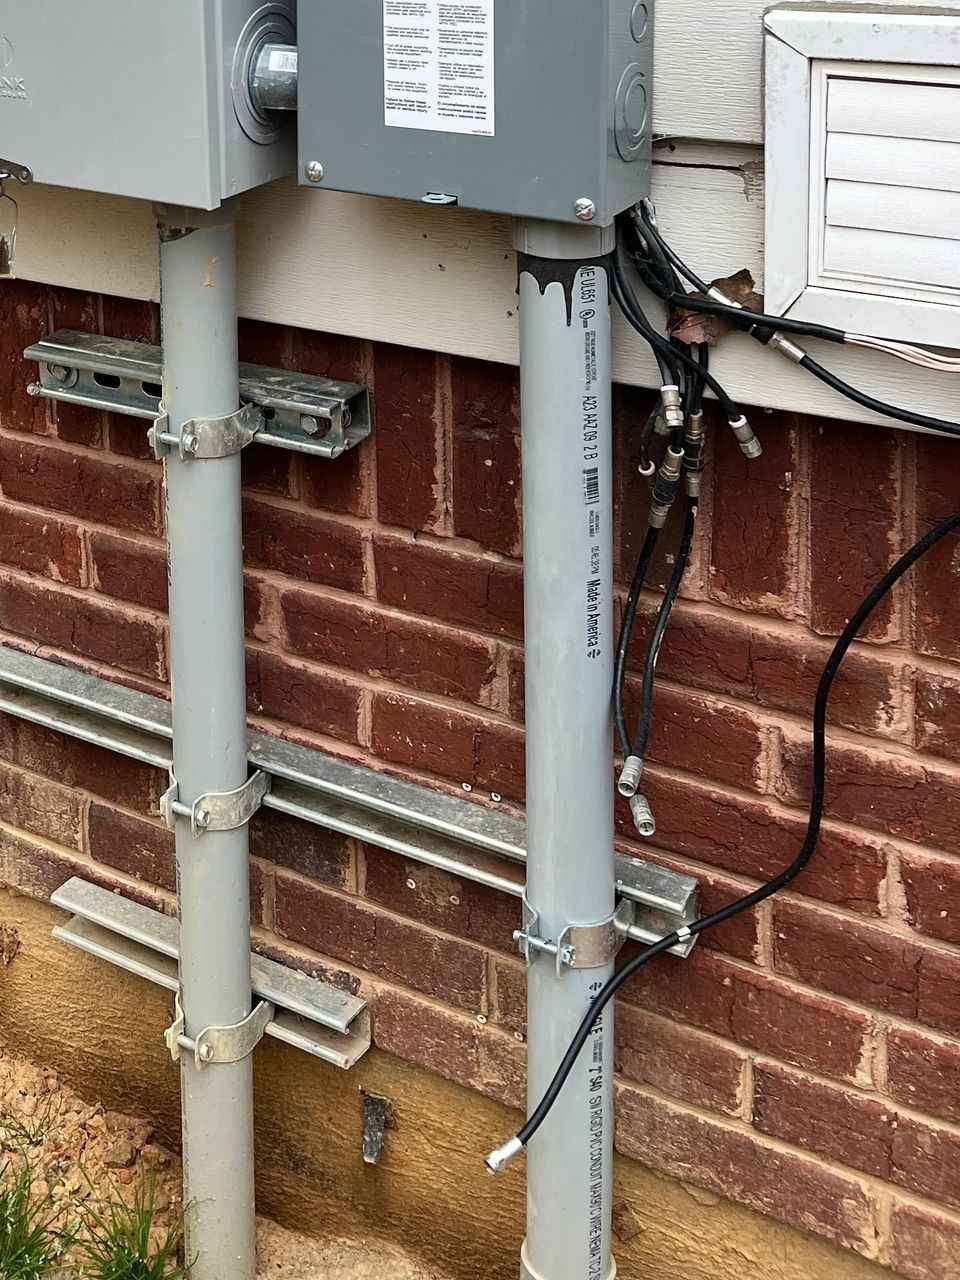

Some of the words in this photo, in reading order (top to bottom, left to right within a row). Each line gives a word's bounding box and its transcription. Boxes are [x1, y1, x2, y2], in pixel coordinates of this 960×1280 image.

[580, 278, 596, 304] UL651
[583, 395, 598, 411] A23
[587, 578, 601, 602] Made
[587, 602, 601, 612] in
[587, 613, 602, 648] America
[589, 1109, 603, 1131] RIGID
[590, 1130, 603, 1148] PVC
[590, 1148, 602, 1181] CONDUIT
[590, 1213, 602, 1236] WIRE
[589, 1234, 602, 1258] NEMA
